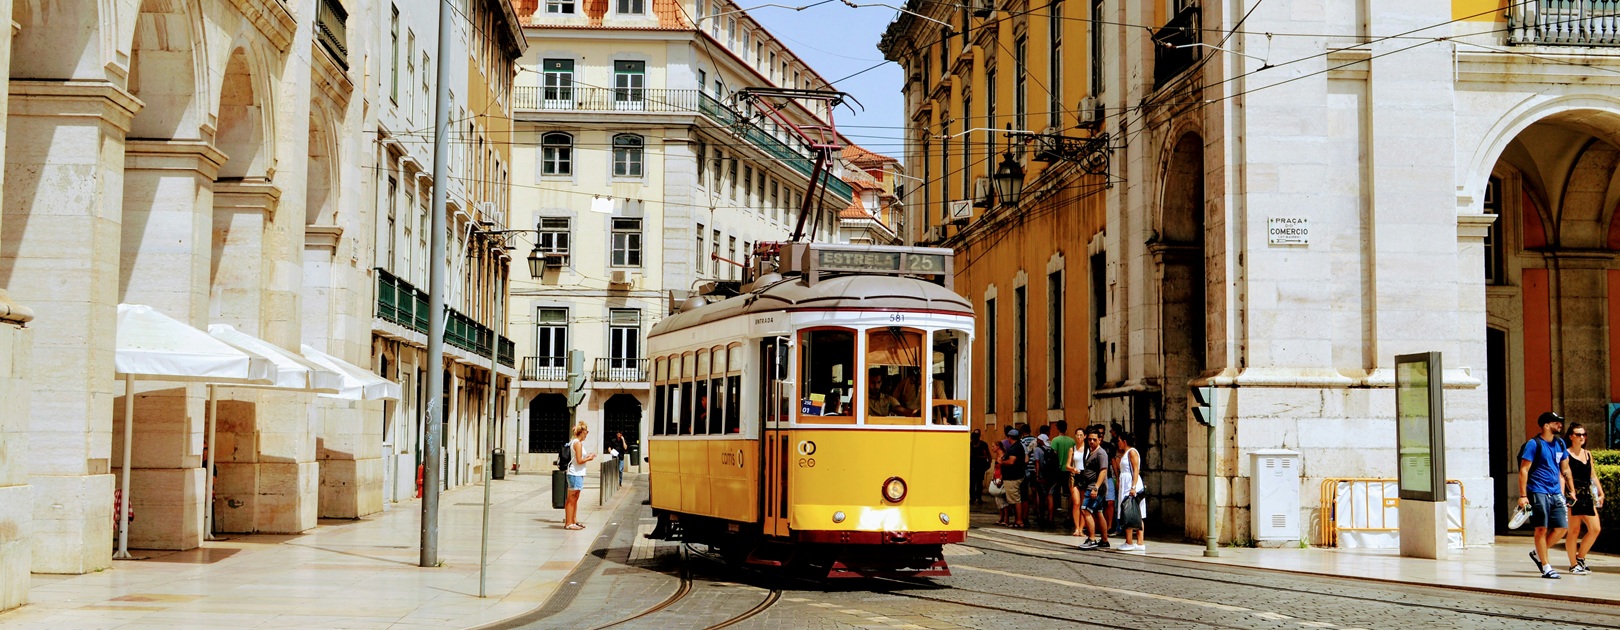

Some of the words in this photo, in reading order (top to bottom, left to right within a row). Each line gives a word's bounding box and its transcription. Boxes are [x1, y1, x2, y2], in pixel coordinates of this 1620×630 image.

[823, 252, 894, 266] ESTRELA
[909, 254, 933, 270] 25
[889, 314, 905, 322] 581
